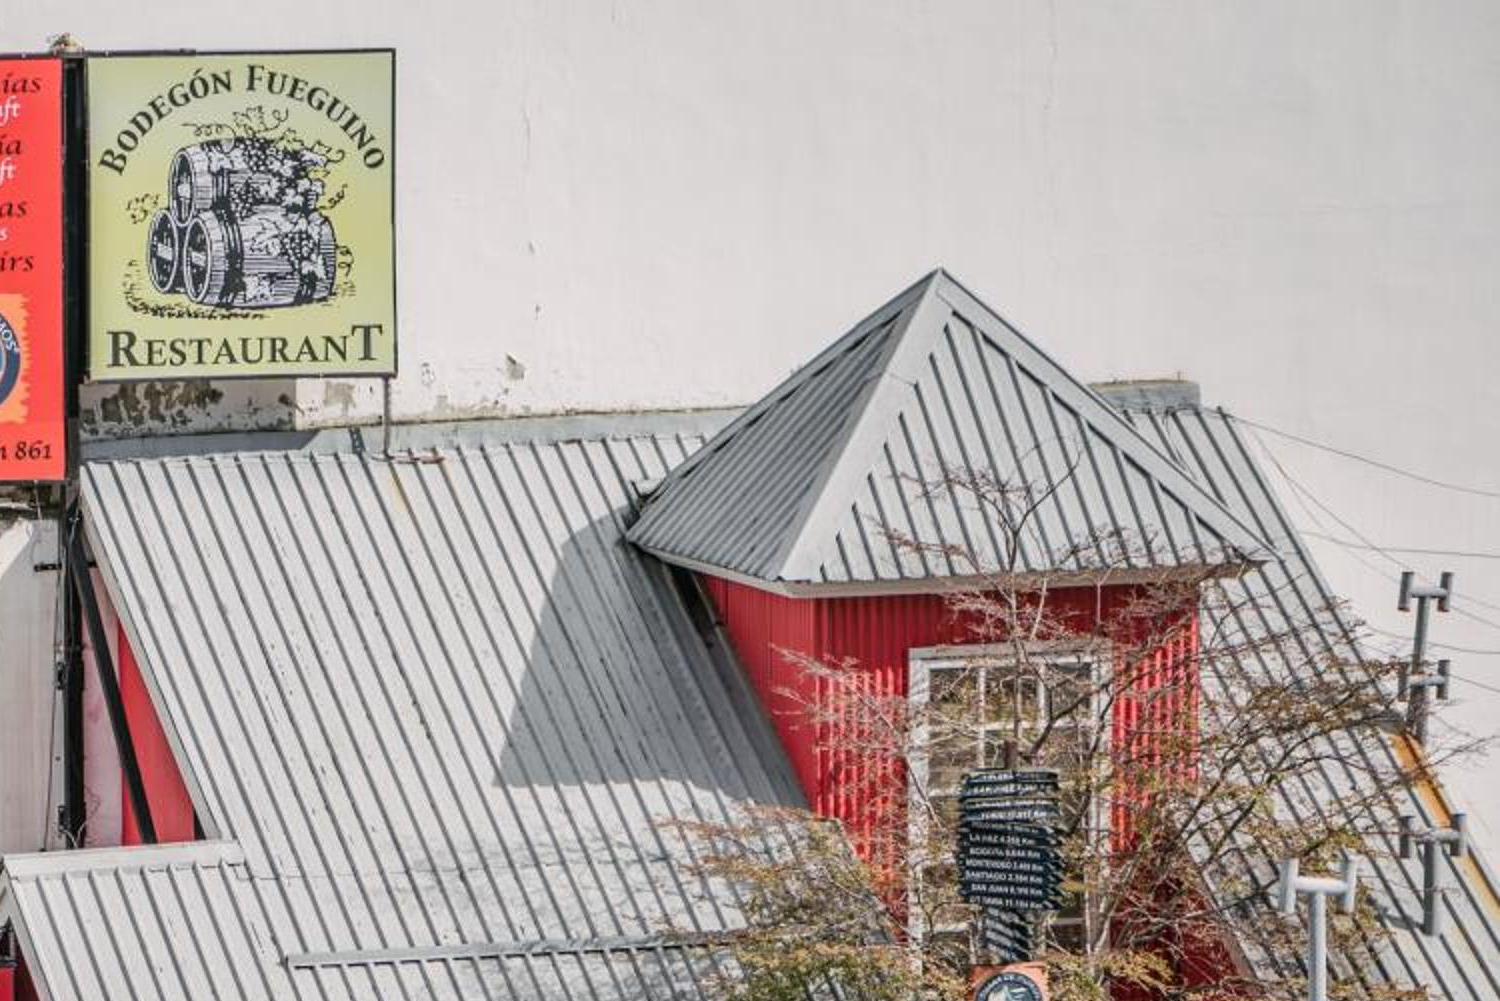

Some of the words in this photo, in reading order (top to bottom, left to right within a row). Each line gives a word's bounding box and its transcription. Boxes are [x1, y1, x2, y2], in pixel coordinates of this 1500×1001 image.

[99, 67, 233, 177] BODEGÓN
[244, 63, 386, 170] FUEGUINO
[106, 323, 384, 368] RESTAURANT
[14, 440, 53, 460] 861
